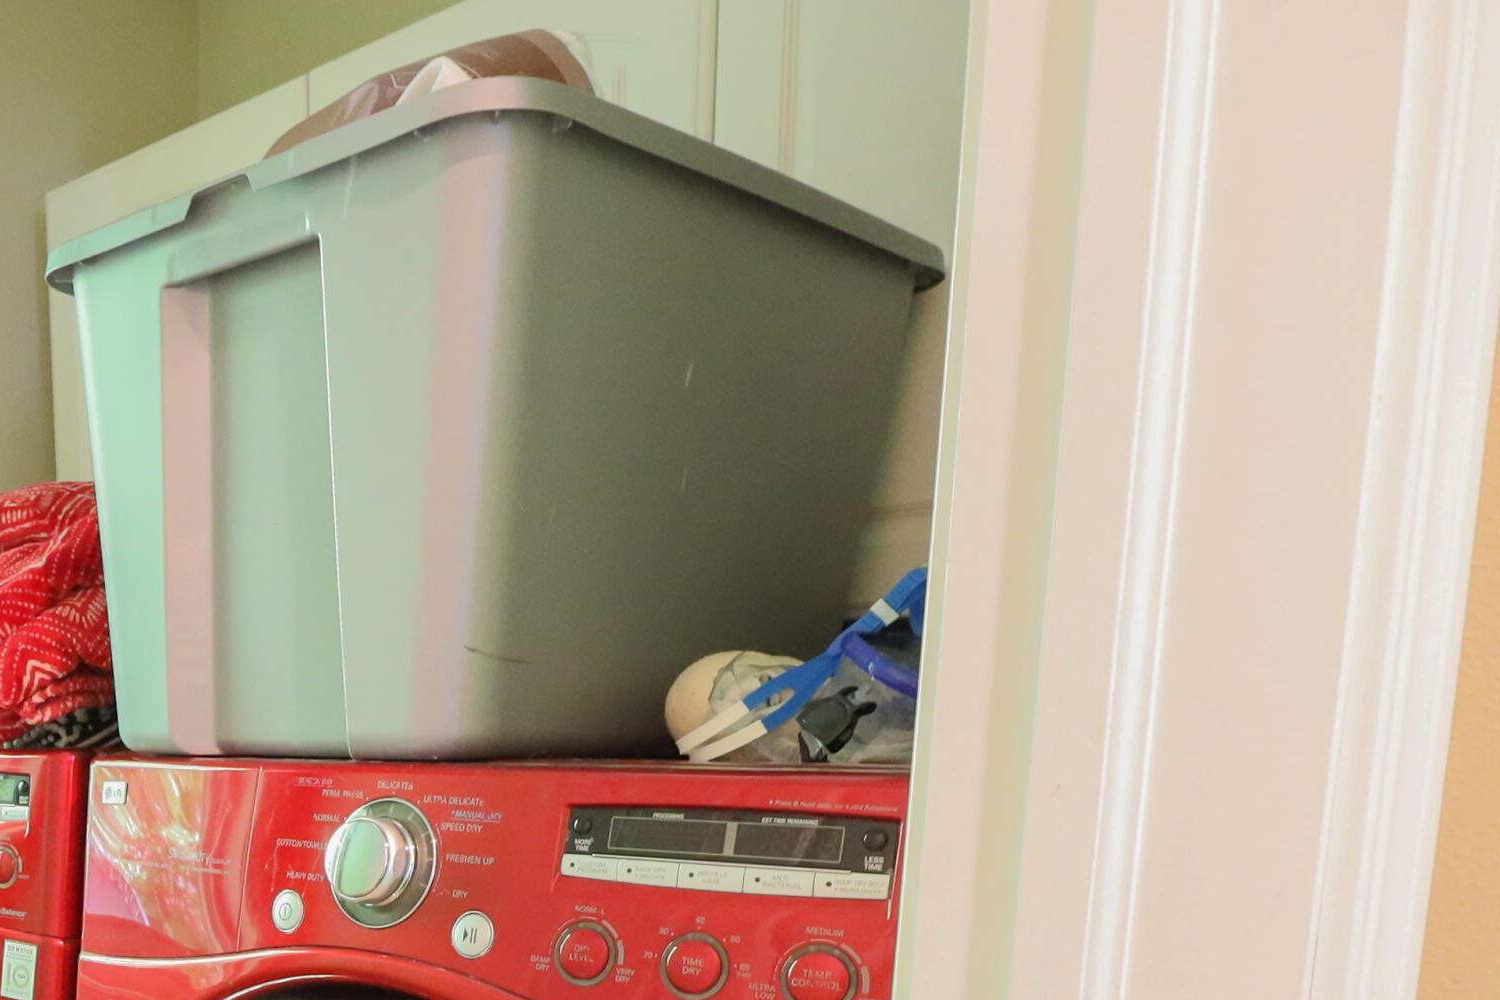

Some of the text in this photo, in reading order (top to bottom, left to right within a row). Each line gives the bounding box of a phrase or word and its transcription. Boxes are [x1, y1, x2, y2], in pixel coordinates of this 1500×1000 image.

[441, 822, 465, 832] SPEED
[445, 853, 495, 866] FRESHEN UP
[864, 863, 883, 871] TIME
[286, 871, 326, 882] HEAVY DUTY
[806, 926, 845, 937] MEDIUM
[682, 957, 705, 967] TIME
[616, 967, 636, 977] VERY
[682, 966, 701, 976] DRY
[614, 975, 631, 983] DRY
[748, 982, 776, 992] ULTRA
[755, 991, 776, 1000] LOW
